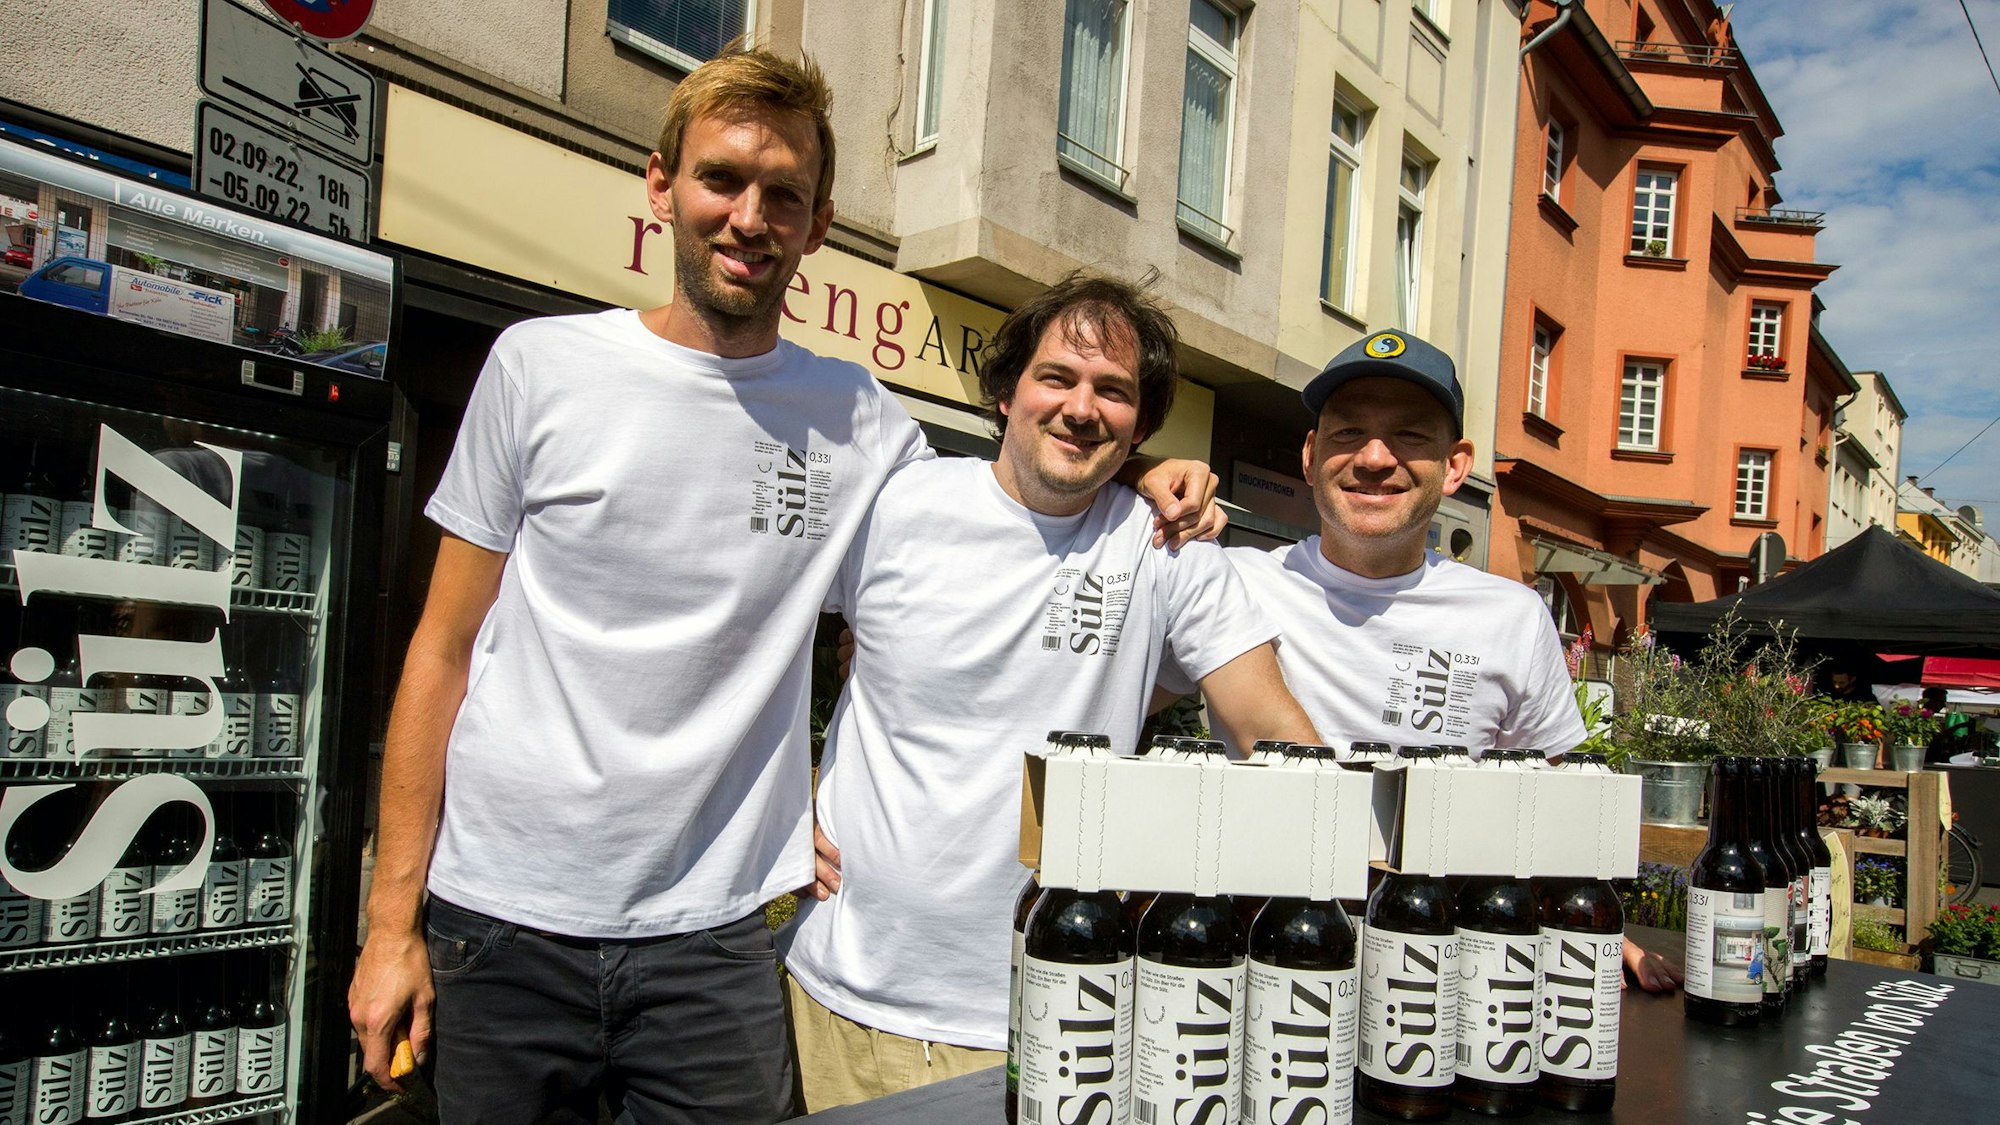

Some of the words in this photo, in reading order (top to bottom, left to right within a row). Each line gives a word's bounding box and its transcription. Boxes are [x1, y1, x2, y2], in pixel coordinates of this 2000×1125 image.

[129, 192, 177, 216] Alle
[182, 206, 270, 244] Marken.
[318, 174, 350, 210] 18h
[329, 213, 350, 238] 5h
[131, 277, 181, 295] Automobile
[776, 447, 807, 538] Sülz
[1239, 472, 1295, 498] DRUCKPATRONEN
[275, 537, 302, 592] Sülz
[1069, 572, 1104, 656] Sülz
[0, 423, 243, 899] Sülz
[1410, 648, 1452, 734] Sülz
[227, 697, 252, 755] Sülz
[268, 698, 294, 753] Sülz
[114, 871, 144, 933] Sülz
[213, 864, 239, 924] Sülz
[261, 861, 286, 918] Sülz
[1384, 942, 1440, 1078] Sülz
[1486, 943, 1536, 1074] Sülz
[1541, 938, 1598, 1070] Sülz
[97, 1048, 129, 1113] Sülz
[145, 1042, 175, 1104] Sülz
[198, 1033, 227, 1093] Sülz
[247, 1031, 274, 1090] Sülz
[1057, 974, 1117, 1125] Sülz
[1173, 978, 1234, 1125] Sülz
[1269, 979, 1332, 1125] Sülz
[1770, 1031, 1911, 1111] Straßen
[1850, 1004, 1933, 1035] von
[40, 1058, 73, 1124] Sülz
